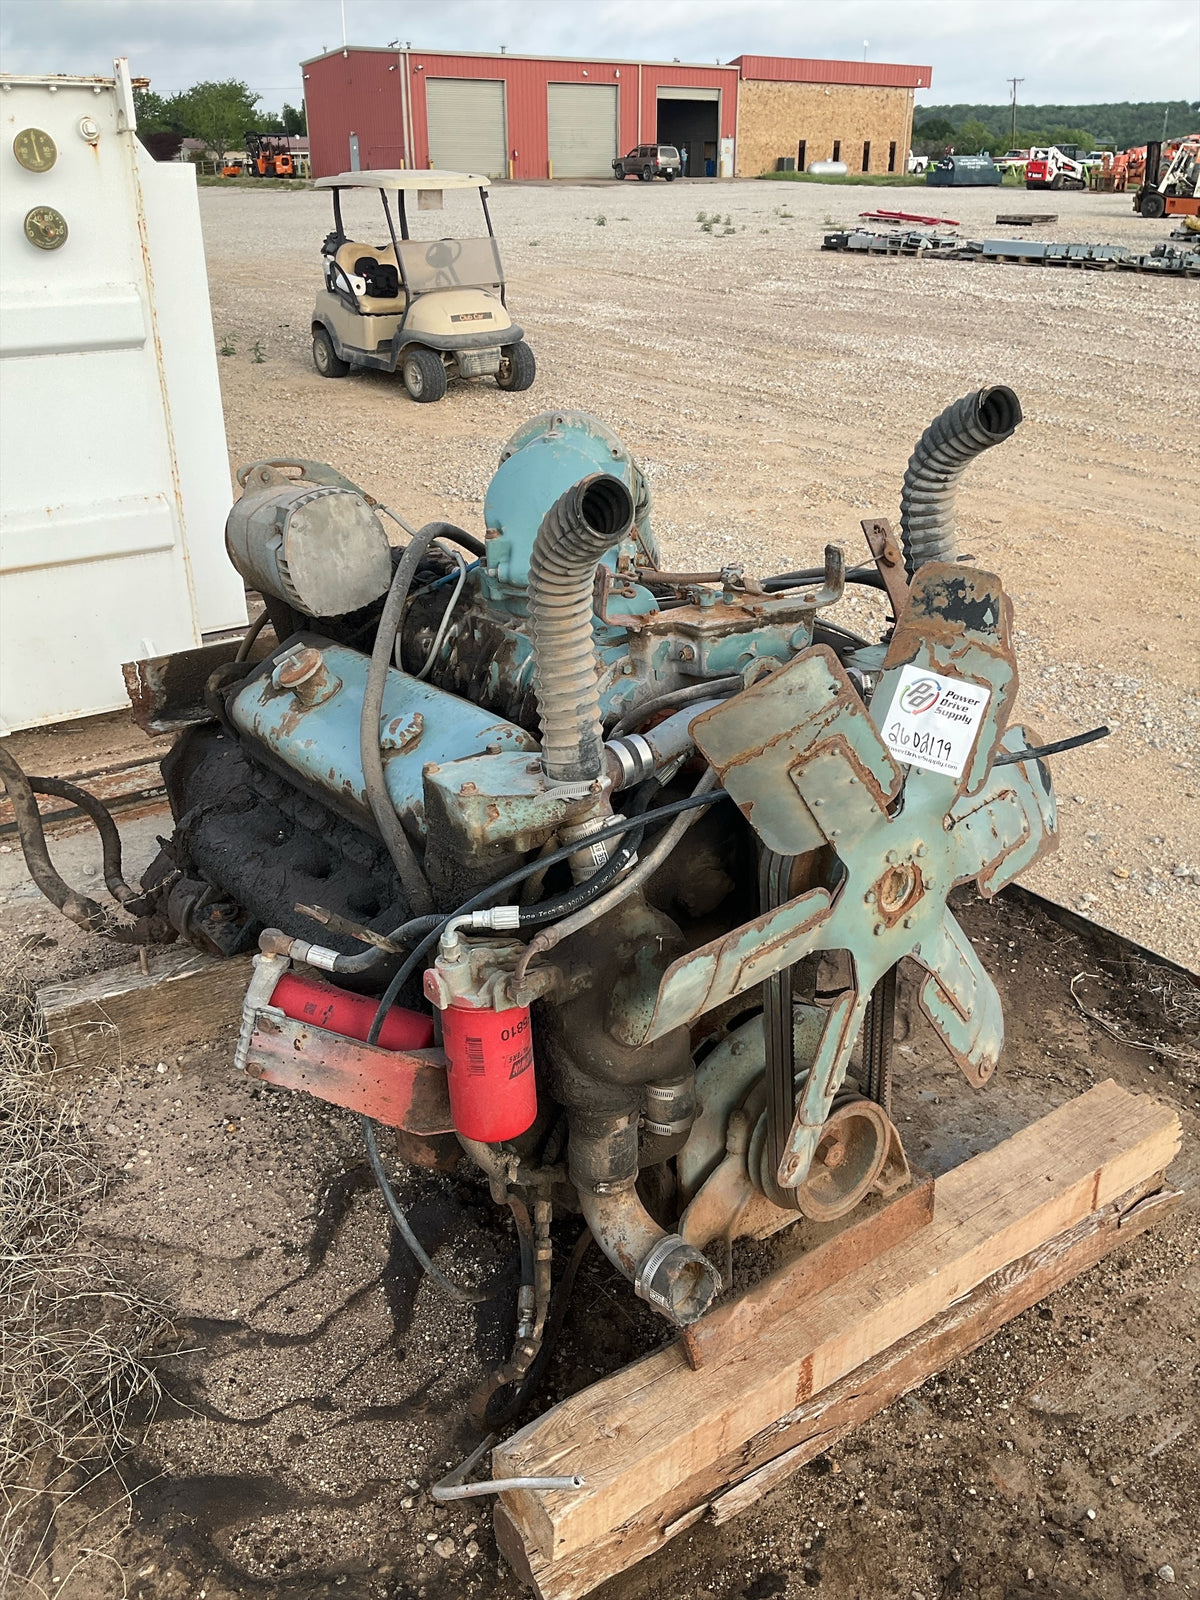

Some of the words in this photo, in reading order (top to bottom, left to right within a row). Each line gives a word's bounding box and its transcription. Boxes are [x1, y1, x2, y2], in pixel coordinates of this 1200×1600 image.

[939, 698, 970, 712] Drive
[944, 690, 981, 706] Power
[934, 706, 973, 725] Supply
